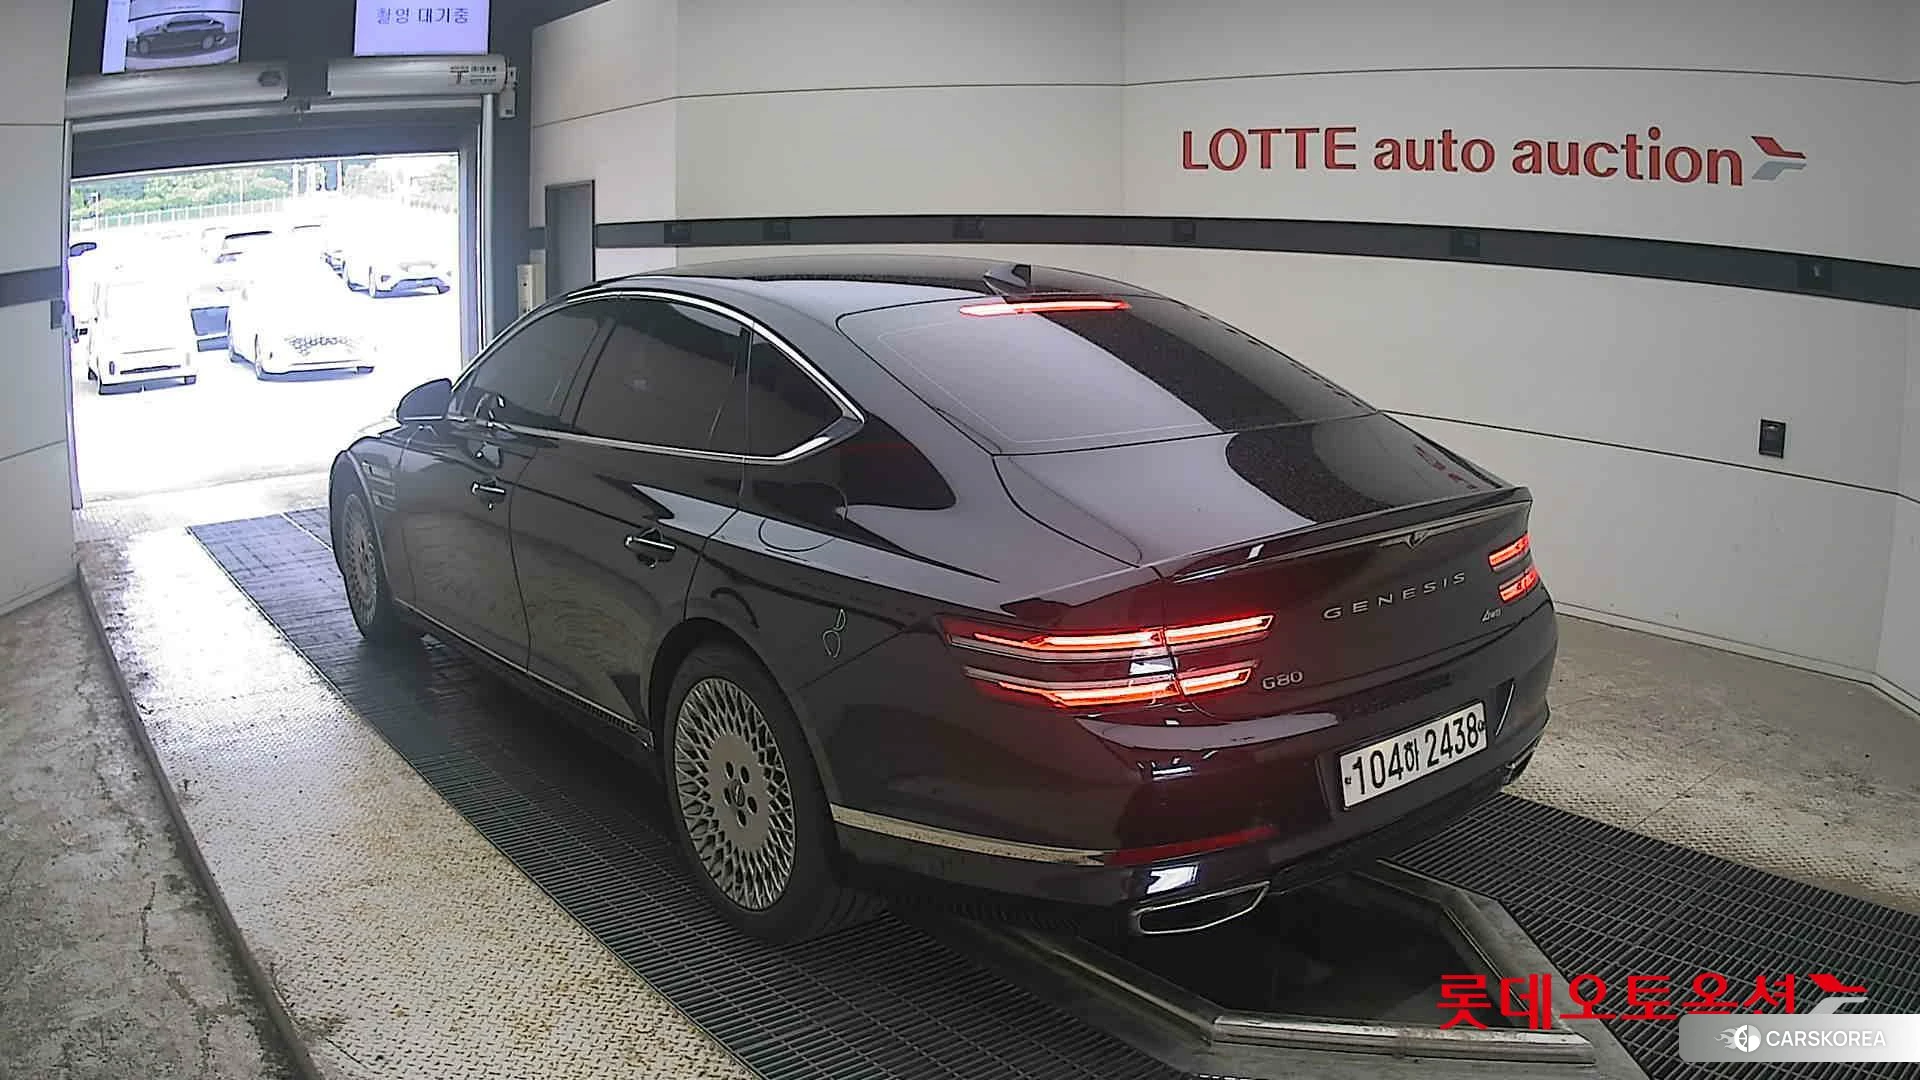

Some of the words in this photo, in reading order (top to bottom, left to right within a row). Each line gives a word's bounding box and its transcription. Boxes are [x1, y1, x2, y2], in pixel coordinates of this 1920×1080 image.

[418, 7, 470, 25] 대기중
[1182, 126, 1358, 171] LOTTE
[1374, 129, 1495, 173] auto
[1513, 127, 1743, 186] auction
[1323, 571, 1466, 620] GENESIS
[1262, 671, 1303, 690] G80
[1352, 737, 1420, 795] 104하
[1424, 711, 1479, 768] 2438
